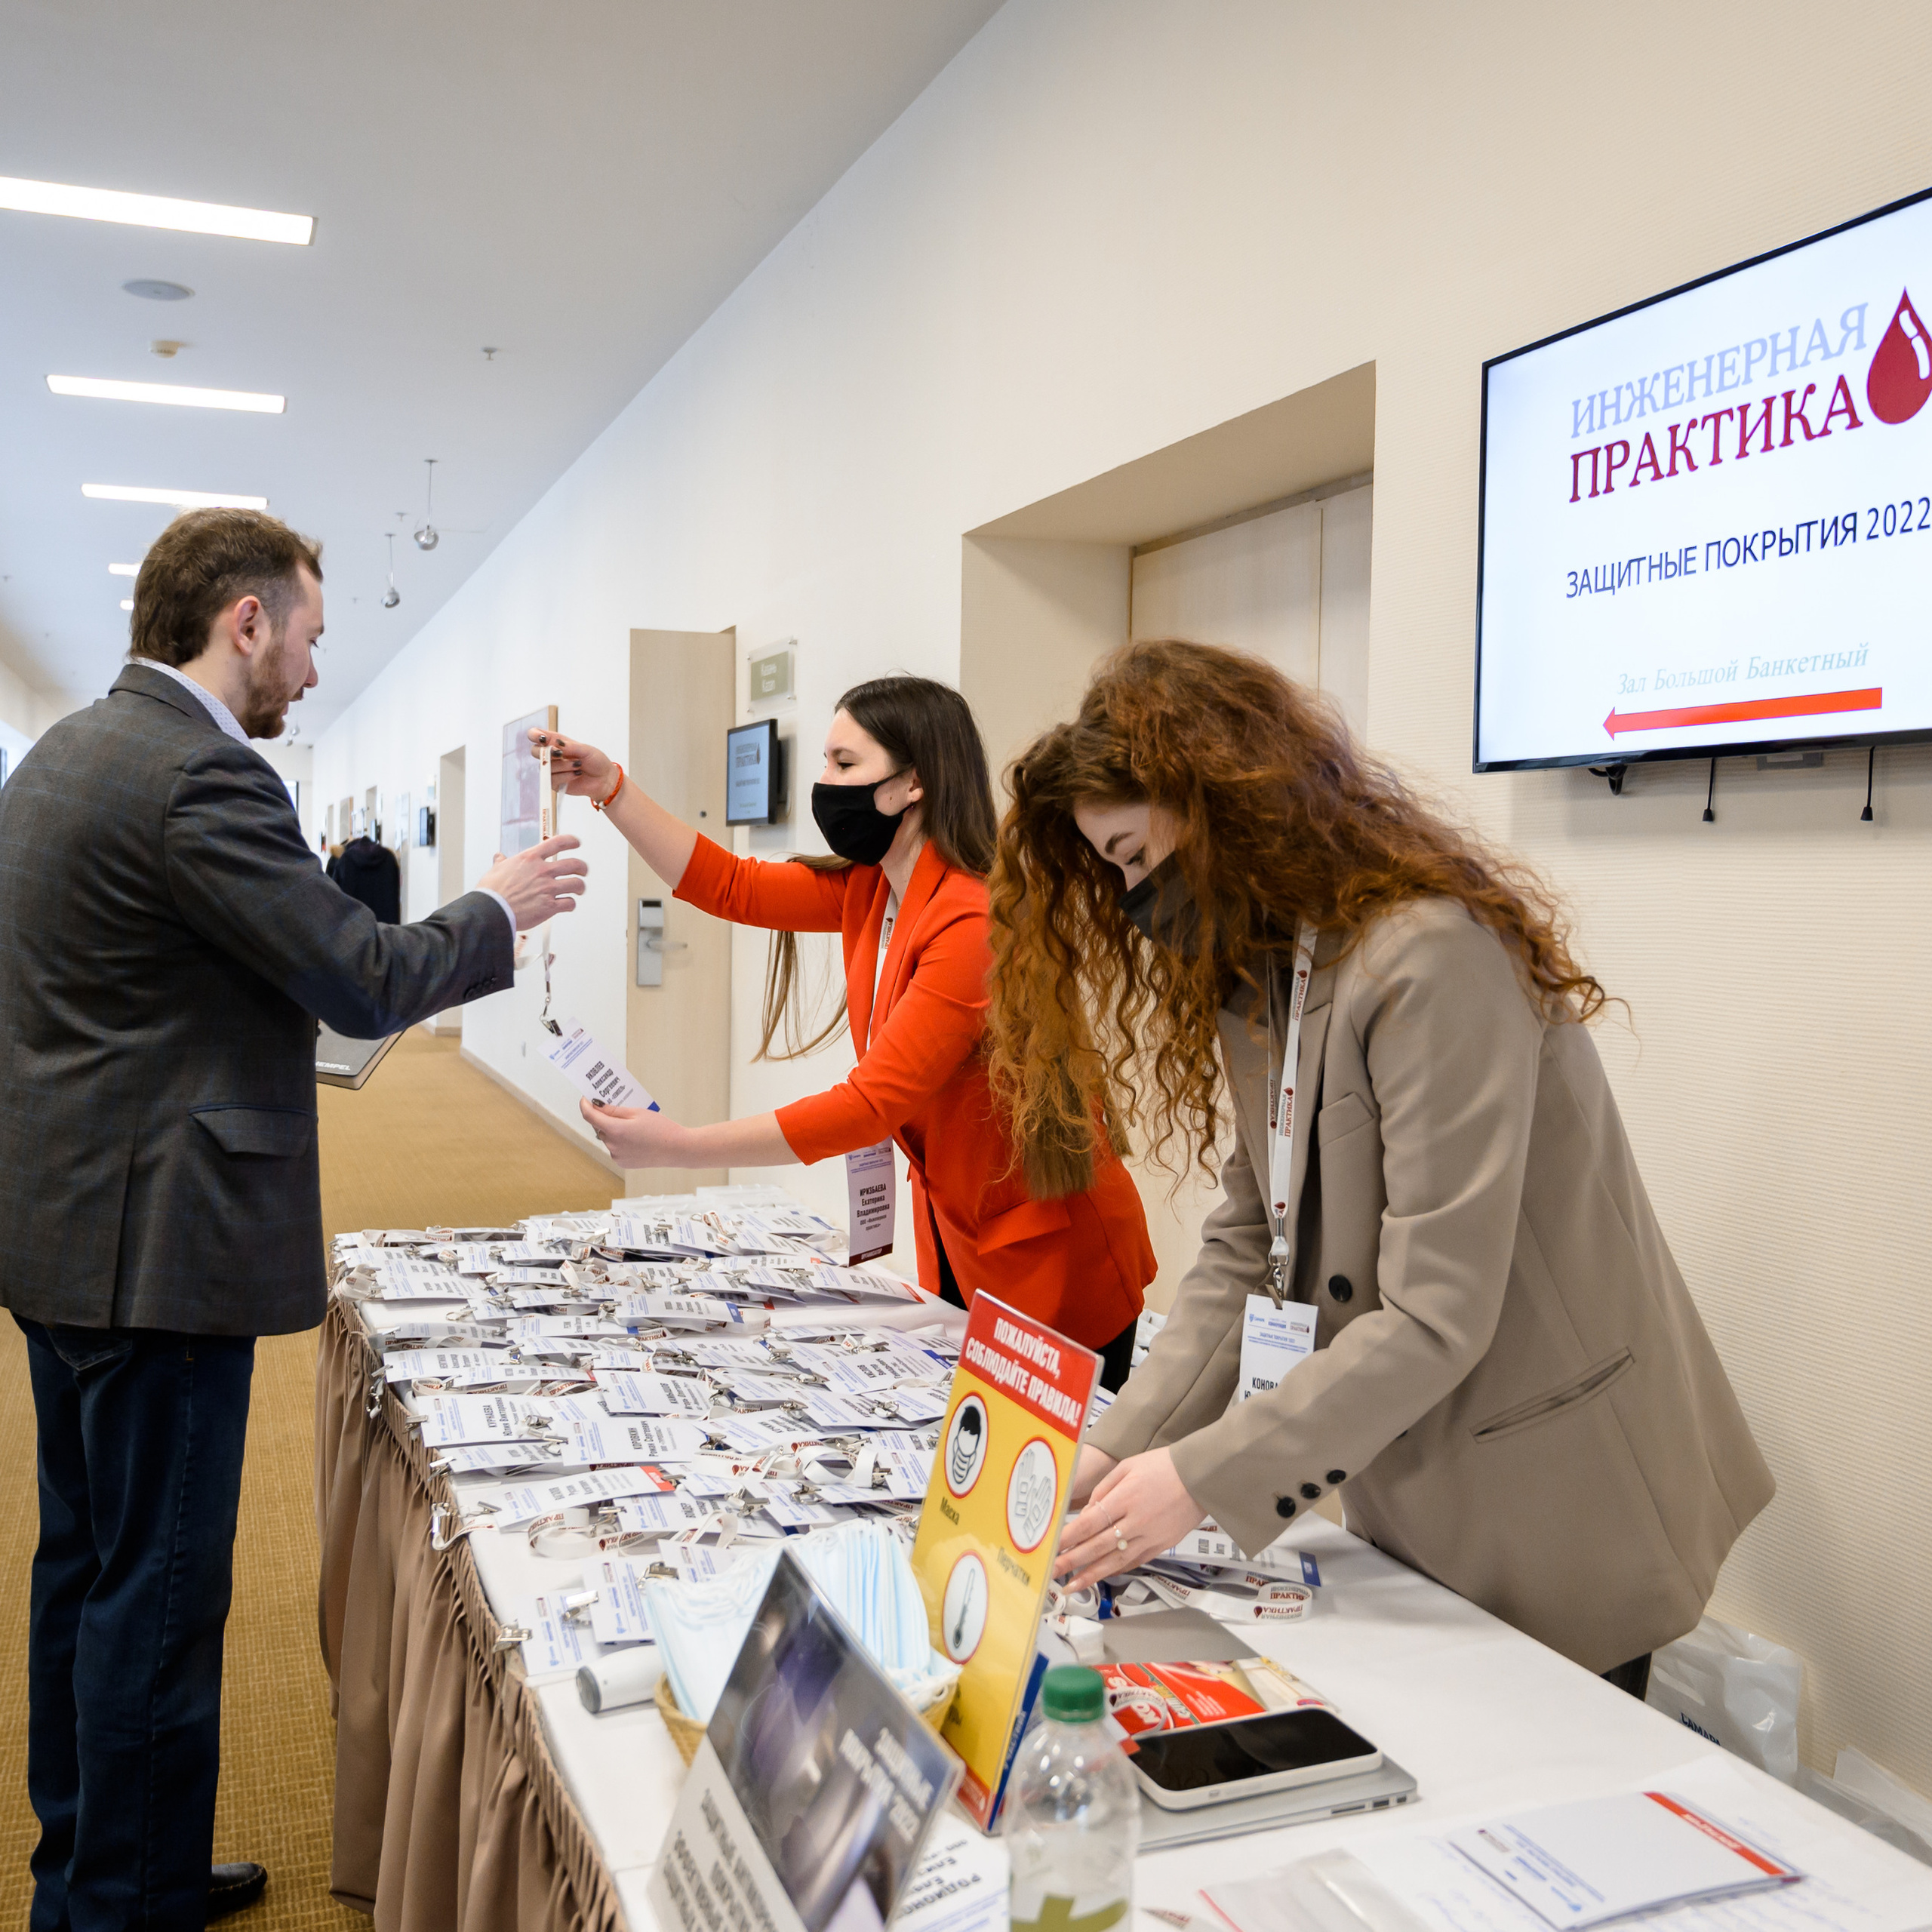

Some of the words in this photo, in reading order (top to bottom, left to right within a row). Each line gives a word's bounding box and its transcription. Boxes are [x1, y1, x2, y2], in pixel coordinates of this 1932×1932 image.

[1570, 302, 1868, 439] ИНЖЕНЕРНАЯ
[1569, 374, 1864, 503] ПРАКТИКА
[1565, 545, 1697, 598] ЗАЩИТНЫЕ
[1704, 512, 1858, 573] ПОКРЫТИЯ
[1866, 496, 1931, 540] 2022
[1617, 673, 1647, 695] Зал
[1653, 659, 1739, 691] Большой
[1746, 641, 1870, 680] Банкетный
[1294, 978, 1306, 1022] ПРАКТИКА
[585, 1060, 605, 1081] ЯКОВЛЕВ
[591, 1068, 614, 1091] Александр
[598, 1076, 621, 1098] Сергеевич
[1284, 1096, 1293, 1137] ПРАКТИКА
[859, 1183, 887, 1197] ИРИЗБАЕВА
[861, 1194, 885, 1207] Екатерина
[857, 1204, 890, 1218] Владимировна
[993, 1317, 1061, 1379] ПОЖАЛУЙСТА,
[964, 1337, 1029, 1395] СОБЛЮДАЙТЕ
[1026, 1375, 1083, 1428] ПРАВИЛА!
[940, 1497, 959, 1526] Маска
[996, 1546, 1031, 1586] Перчатки
[1245, 1576, 1269, 1587] ПРАК
[1262, 1604, 1303, 1614] ПРАКТИКА
